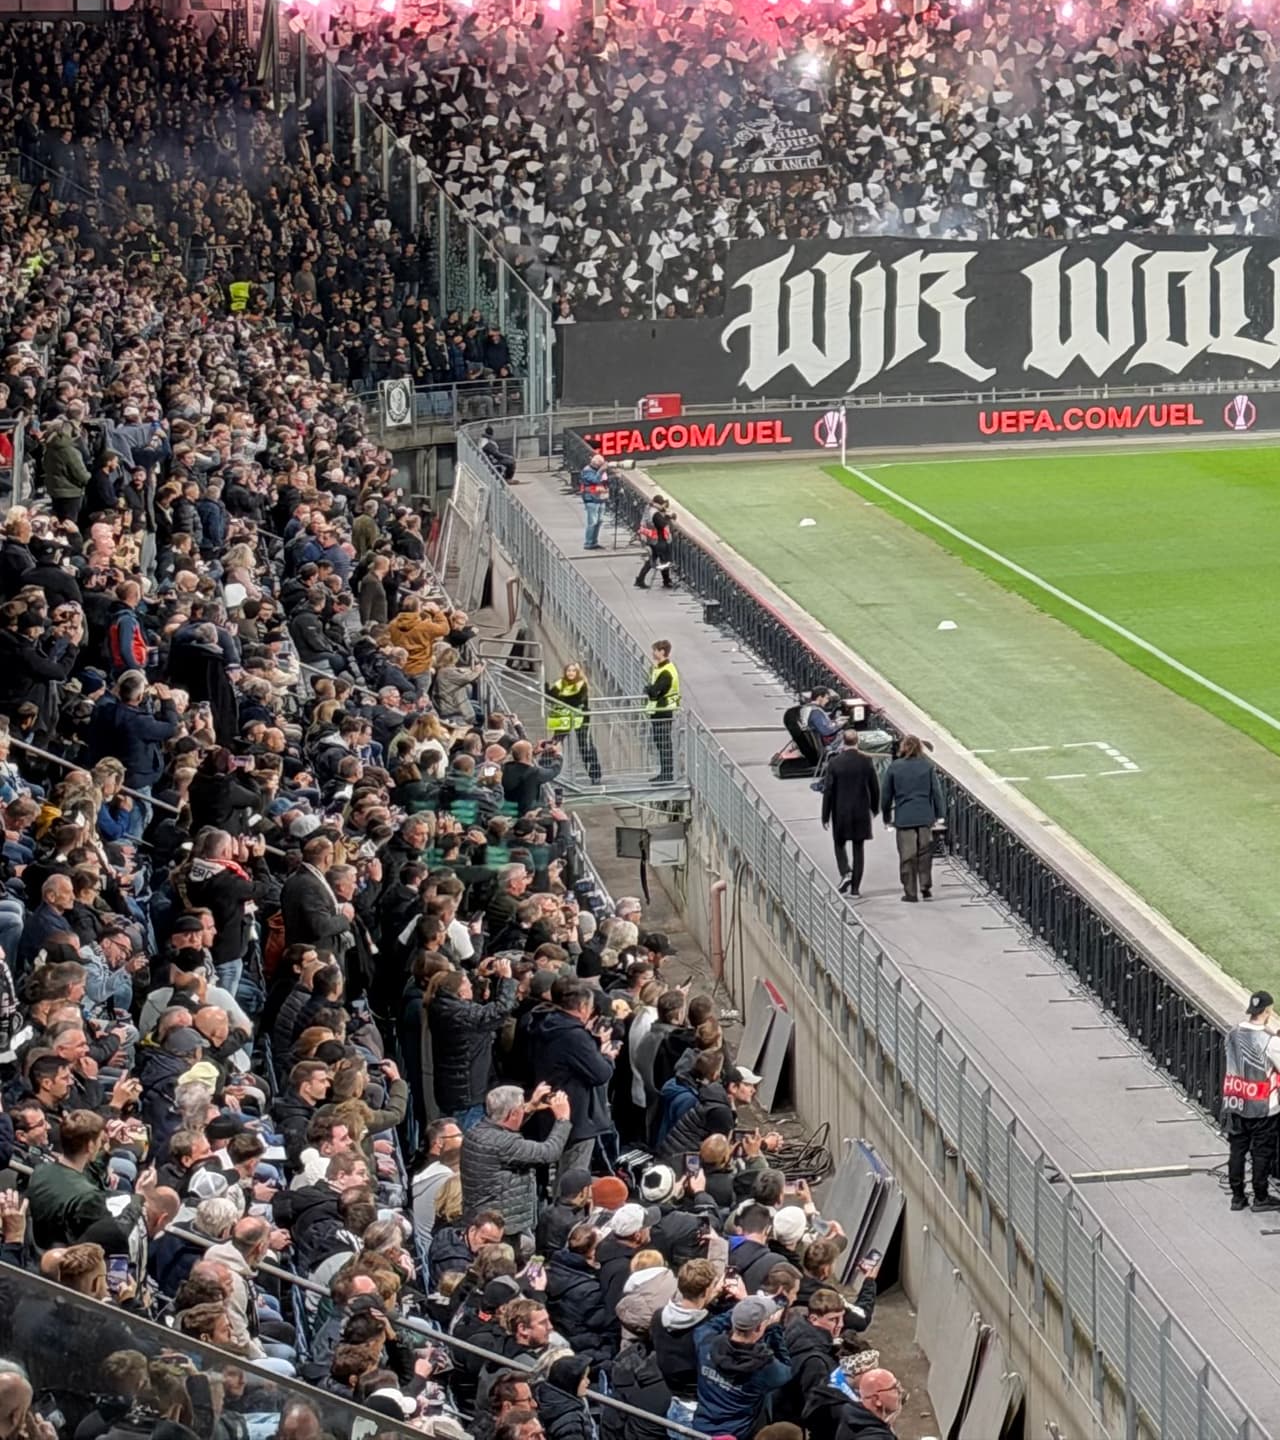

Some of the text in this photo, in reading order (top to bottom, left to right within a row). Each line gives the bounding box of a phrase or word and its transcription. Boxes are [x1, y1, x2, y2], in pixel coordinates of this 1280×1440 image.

[721, 244, 997, 393] WIR
[979, 403, 1203, 435] UEFA.COM/UEL
[1224, 1077, 1258, 1097] HOTO
